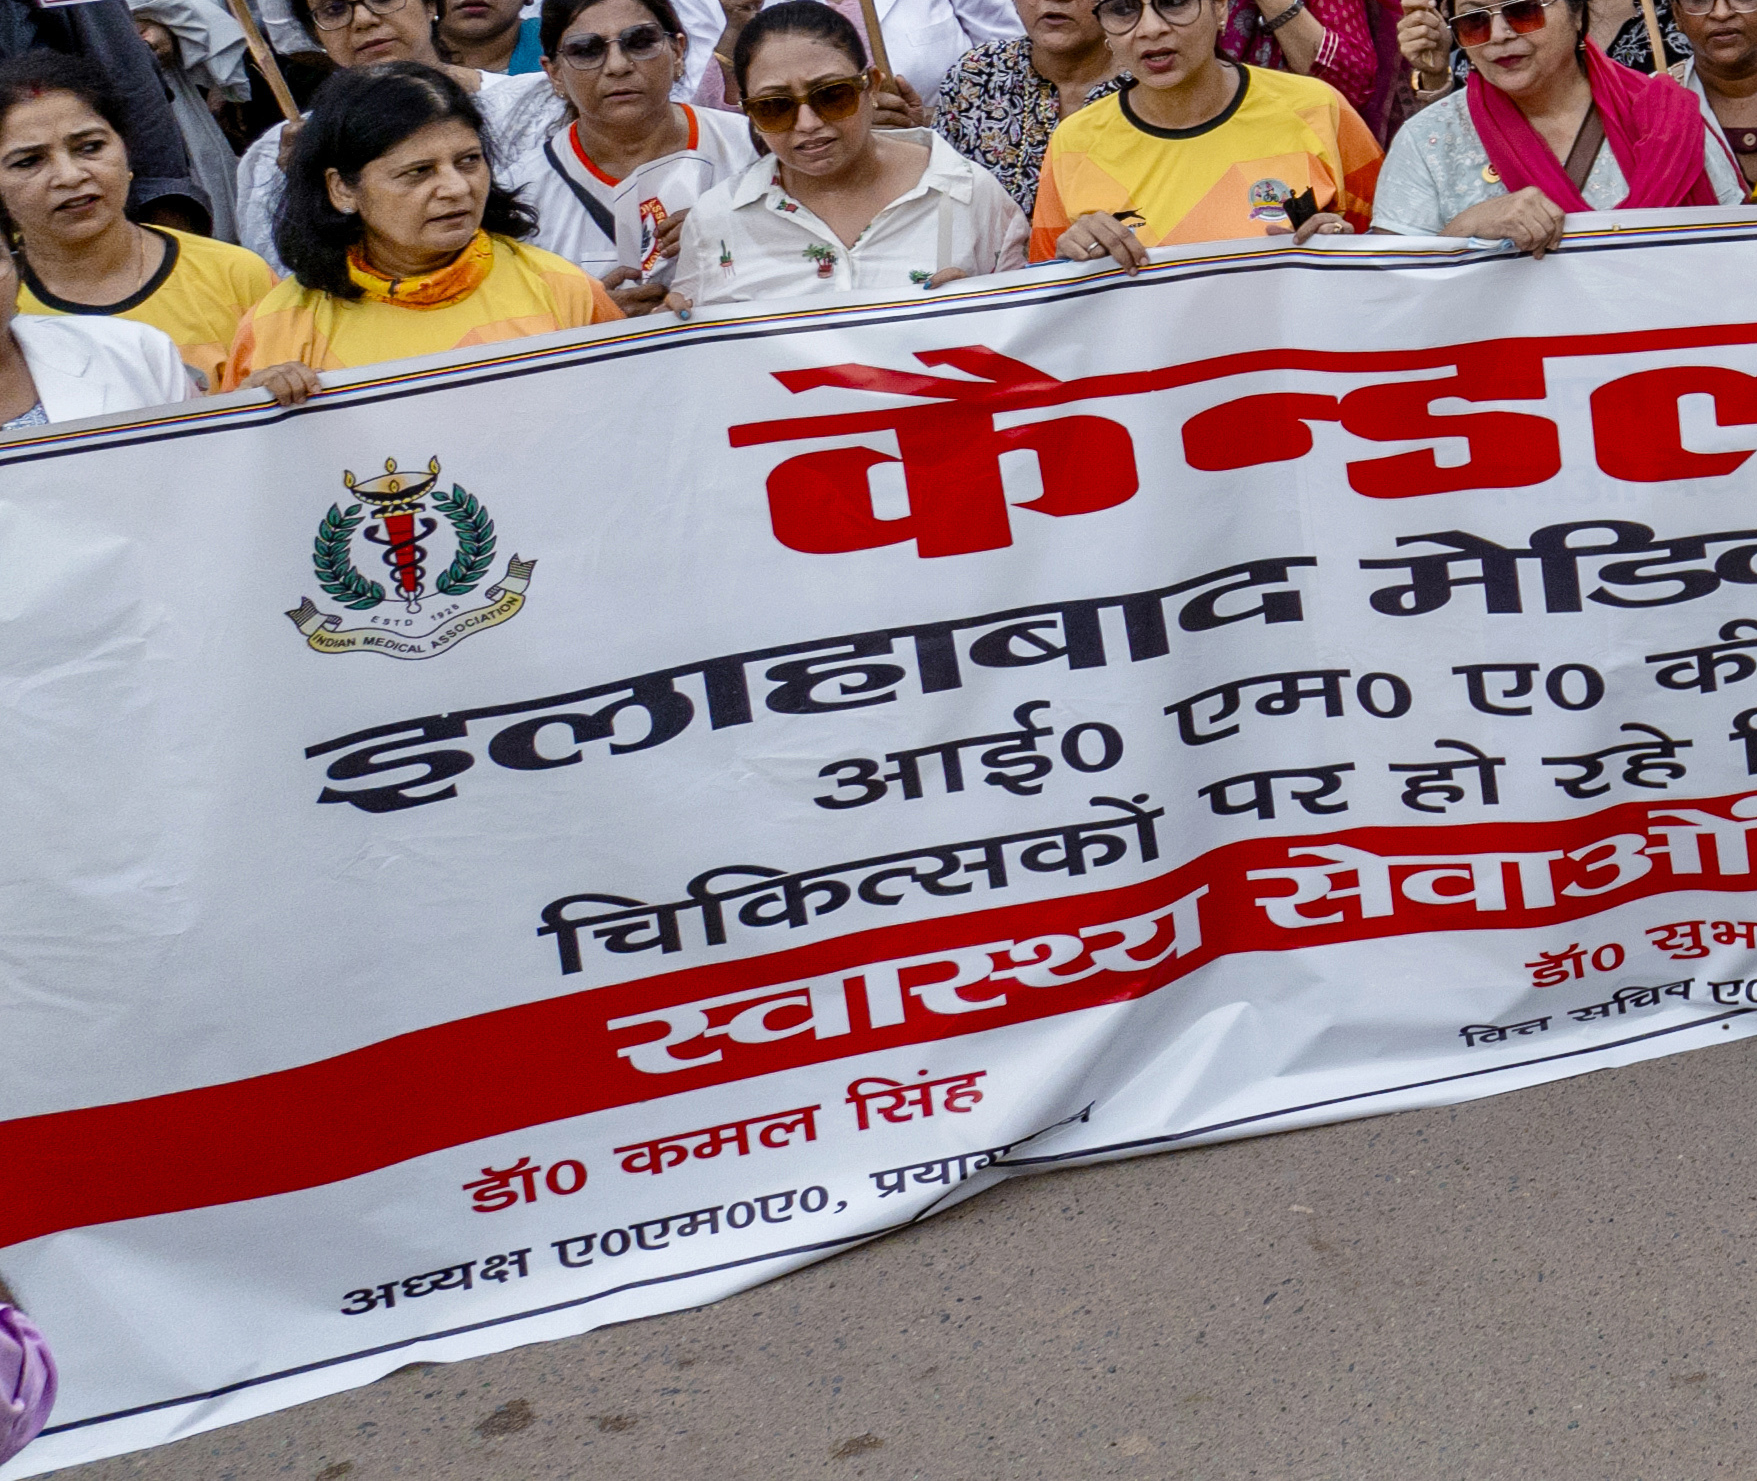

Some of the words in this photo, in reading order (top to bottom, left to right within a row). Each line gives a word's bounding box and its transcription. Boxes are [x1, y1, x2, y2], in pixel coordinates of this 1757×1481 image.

[305, 555, 1319, 813] इलाहाबाद
[540, 790, 1163, 972] चिकित्सकों
[1200, 760, 1354, 822] पर
[1389, 738, 1504, 813] हो
[1542, 720, 1692, 799] रहे
[604, 883, 1210, 1074] स्वास्थ्य
[614, 1104, 821, 1175] कमल
[845, 1069, 986, 1130] सिंह
